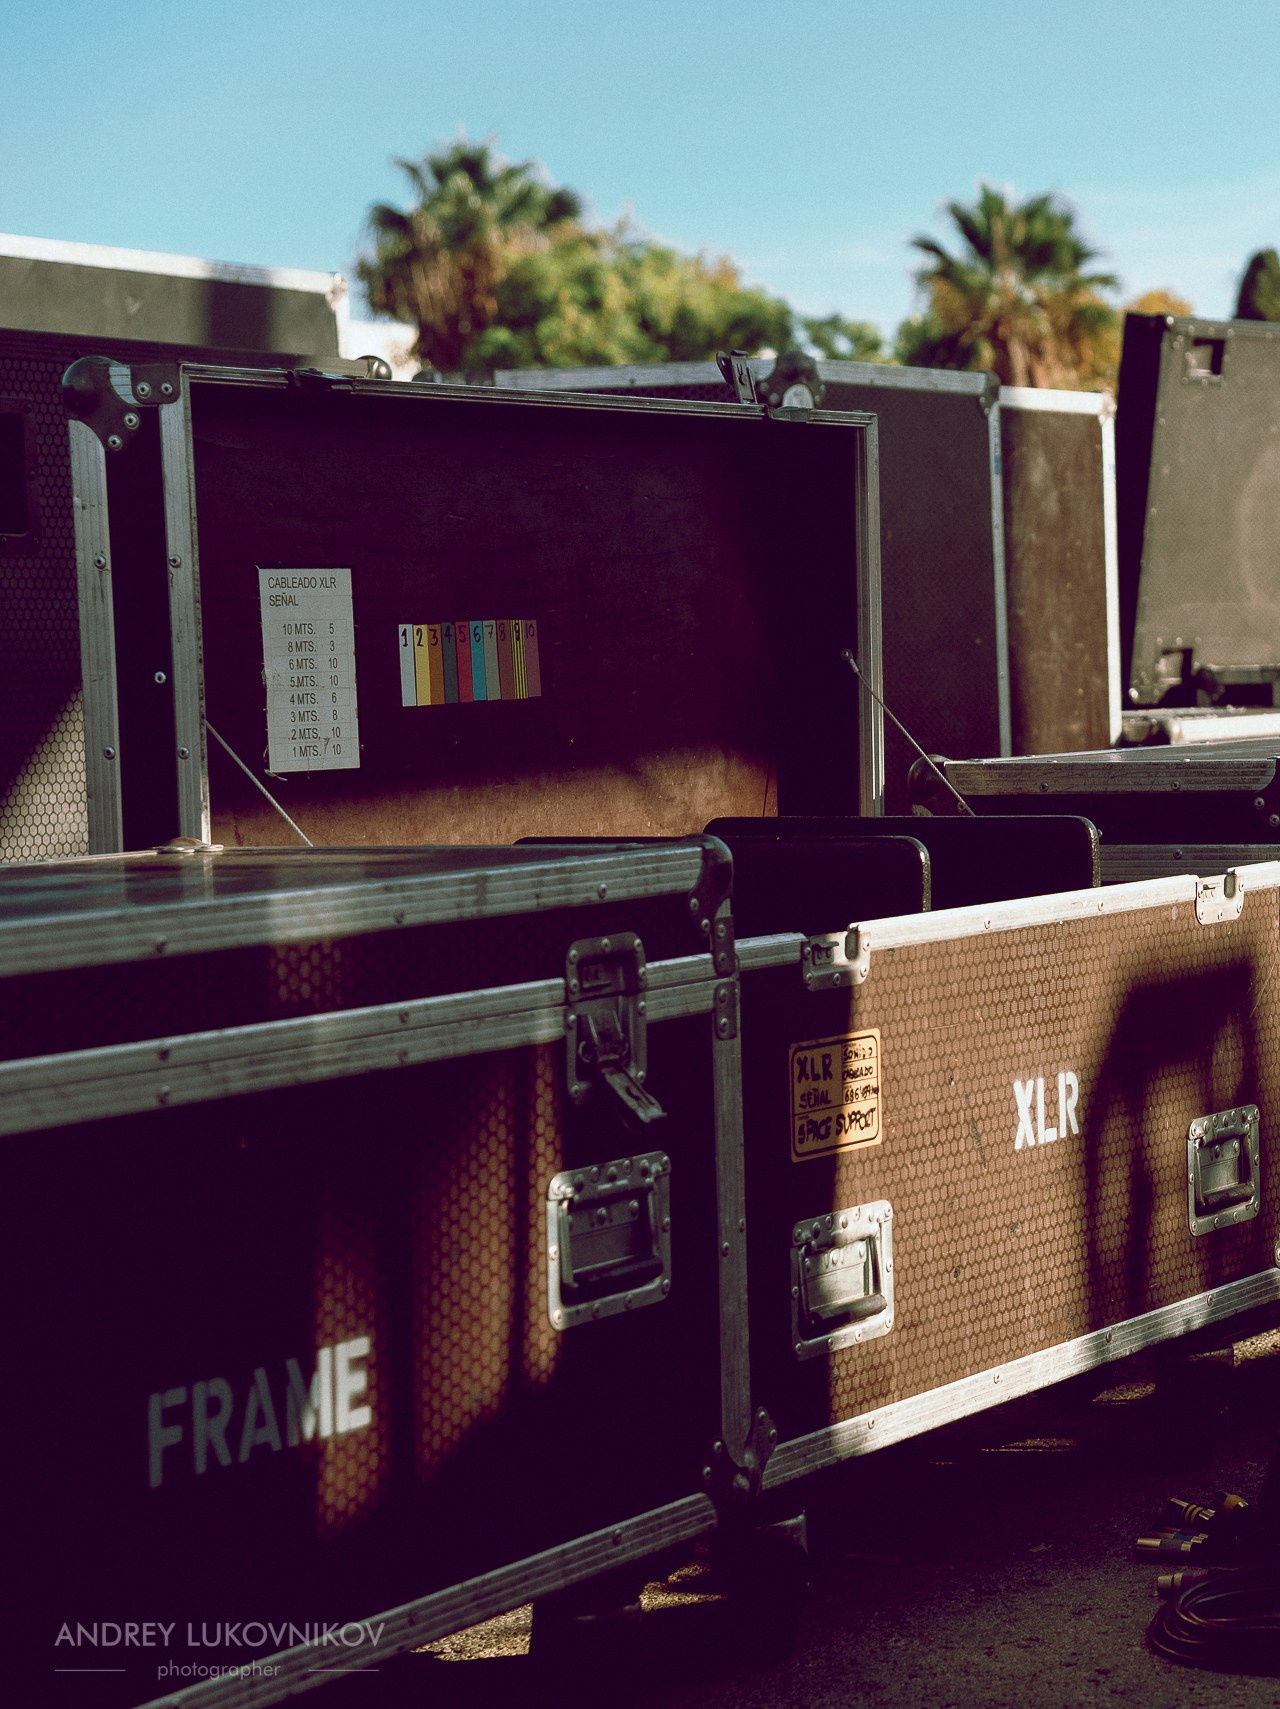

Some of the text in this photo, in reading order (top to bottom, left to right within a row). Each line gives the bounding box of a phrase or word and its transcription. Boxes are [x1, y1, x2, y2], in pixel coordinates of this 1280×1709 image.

[268, 577, 336, 589] CABLEADO XLR
[269, 592, 299, 607] SEÑAL
[283, 623, 335, 635] 10 MTS. 5
[401, 623, 535, 647] 1 2 3 4 5 6 7 8 9 10
[287, 640, 335, 652] 8 MTS. 3
[288, 658, 338, 670] 6 MTS. 10
[290, 675, 339, 688] 5 MTS. 10
[290, 692, 337, 705] 4 MTS. 6
[290, 710, 338, 722] 3 MTS. 8
[291, 727, 341, 740] 2 MTS. 10
[292, 744, 342, 757] 1 MTS. 10
[797, 1054, 832, 1083] XLR
[799, 1088, 832, 1109] SEÑAL
[1013, 1071, 1080, 1150] XLR
[835, 1107, 876, 1136] SUPPORT
[148, 1336, 372, 1489] FRAME
